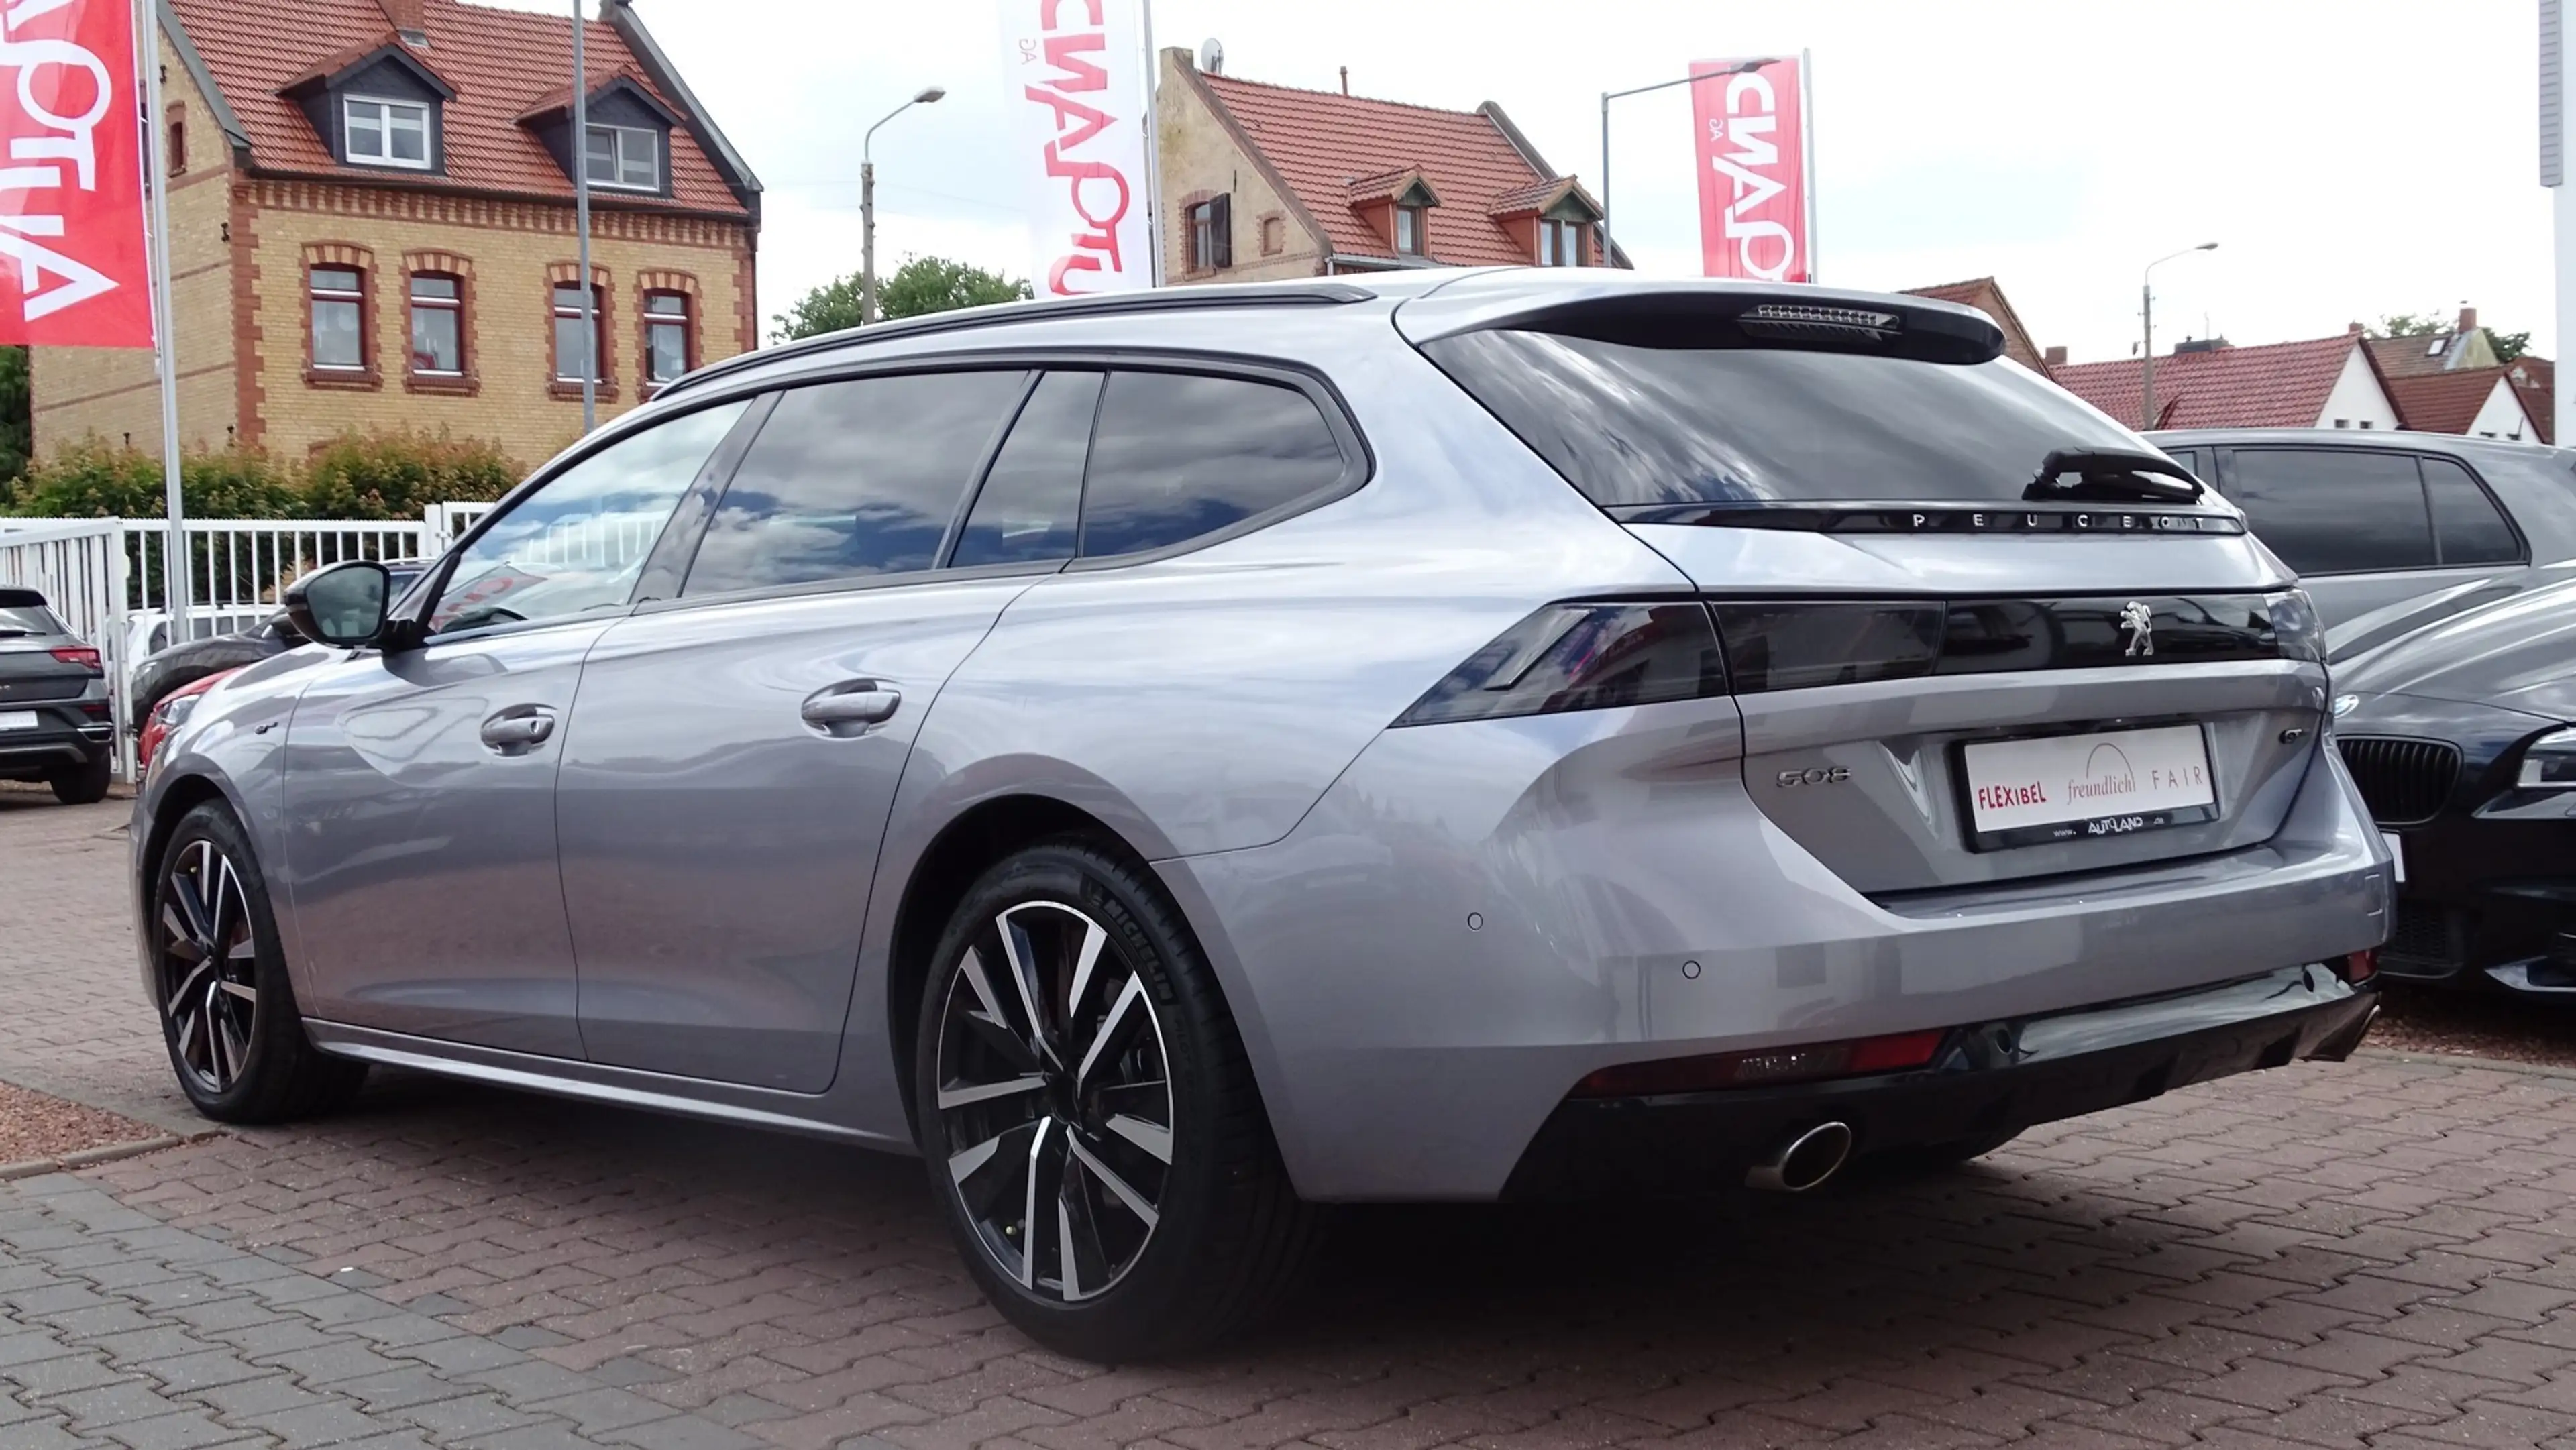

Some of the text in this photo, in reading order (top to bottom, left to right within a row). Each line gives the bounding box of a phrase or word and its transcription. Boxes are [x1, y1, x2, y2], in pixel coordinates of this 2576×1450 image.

[1913, 514, 2204, 530] PEUGEOT
[1776, 767, 1851, 787] 508
[1978, 765, 2203, 810] FLEXIBEL freundlich FAIR
[2088, 816, 2144, 836] AUTOLAND
[1102, 899, 1175, 1000] MICHELIN
